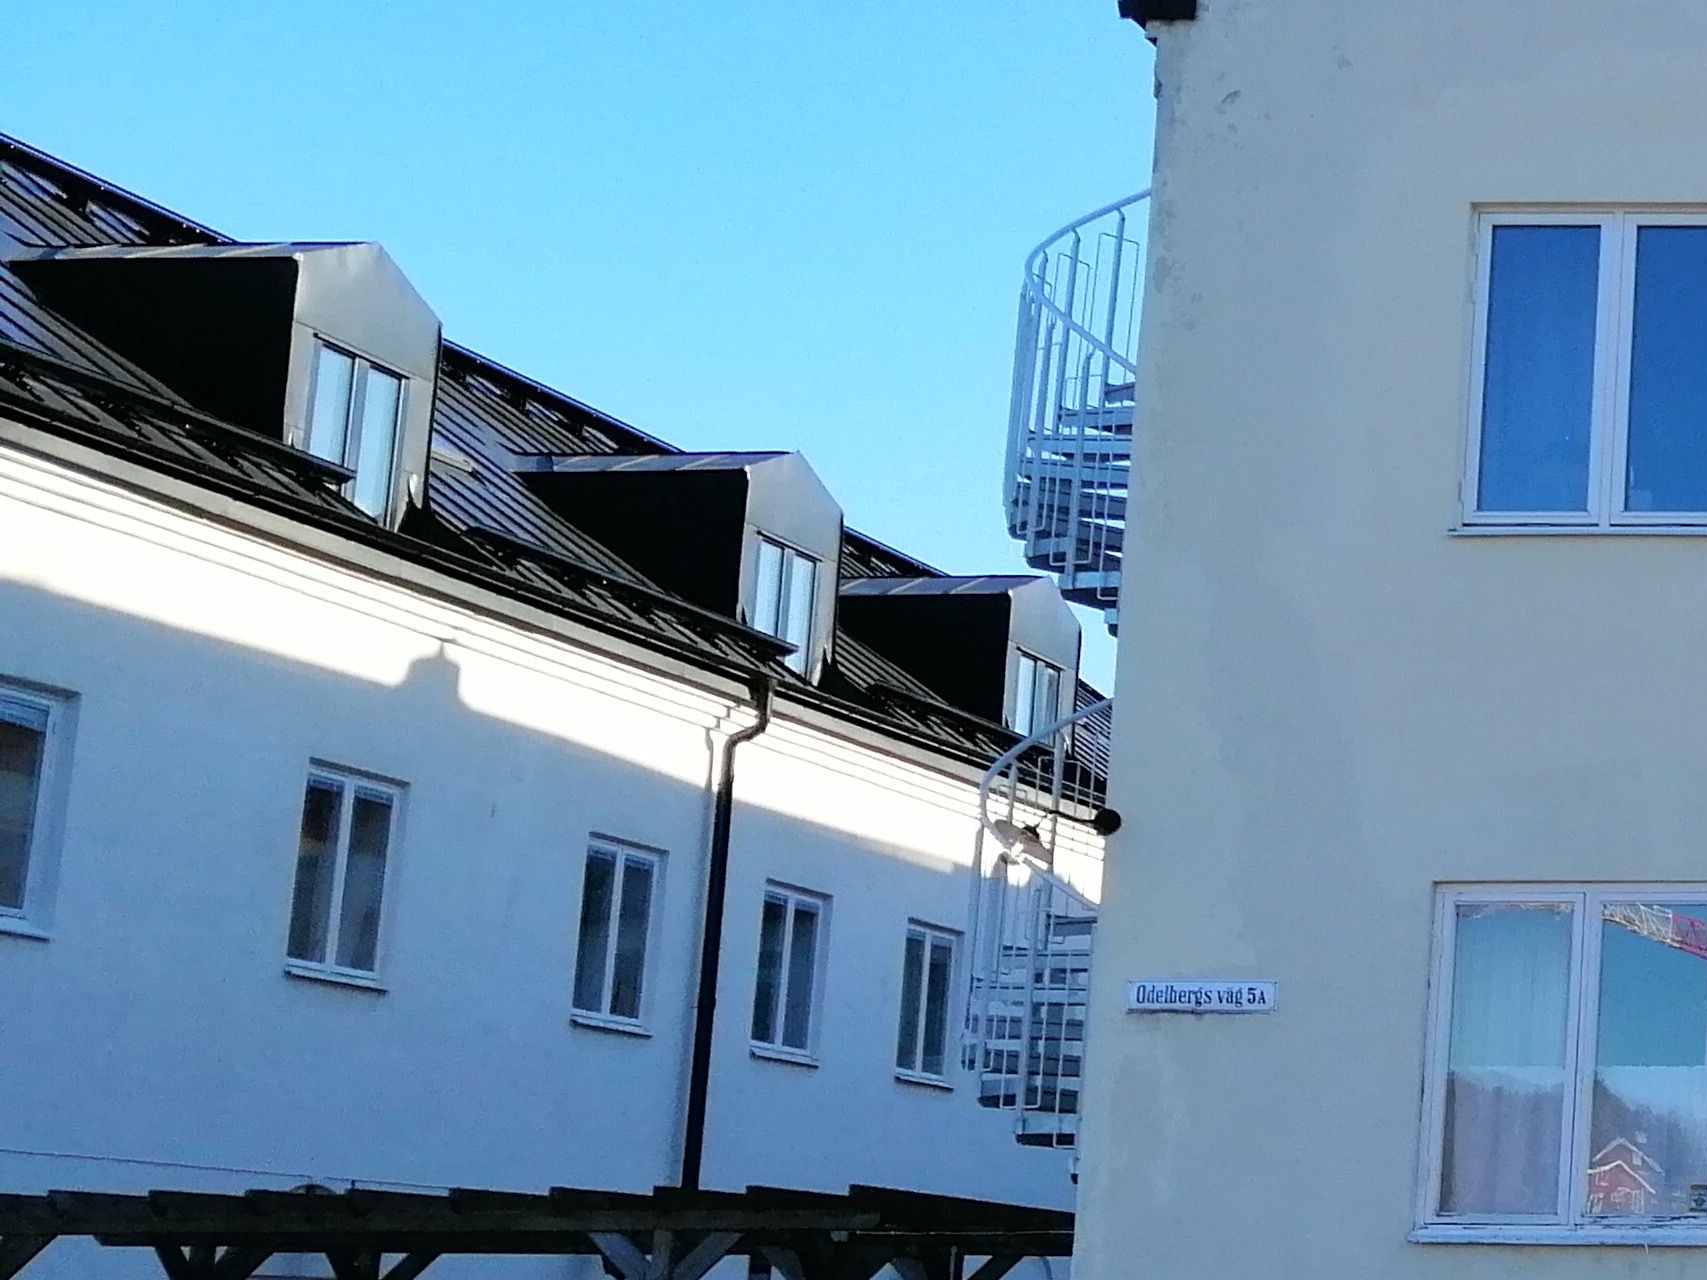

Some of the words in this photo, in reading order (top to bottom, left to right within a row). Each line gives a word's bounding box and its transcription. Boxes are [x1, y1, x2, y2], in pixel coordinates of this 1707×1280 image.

[1136, 984, 1213, 1007] Odelbergs
[1217, 987, 1244, 1007] väg
[1247, 987, 1266, 1005] 5A
